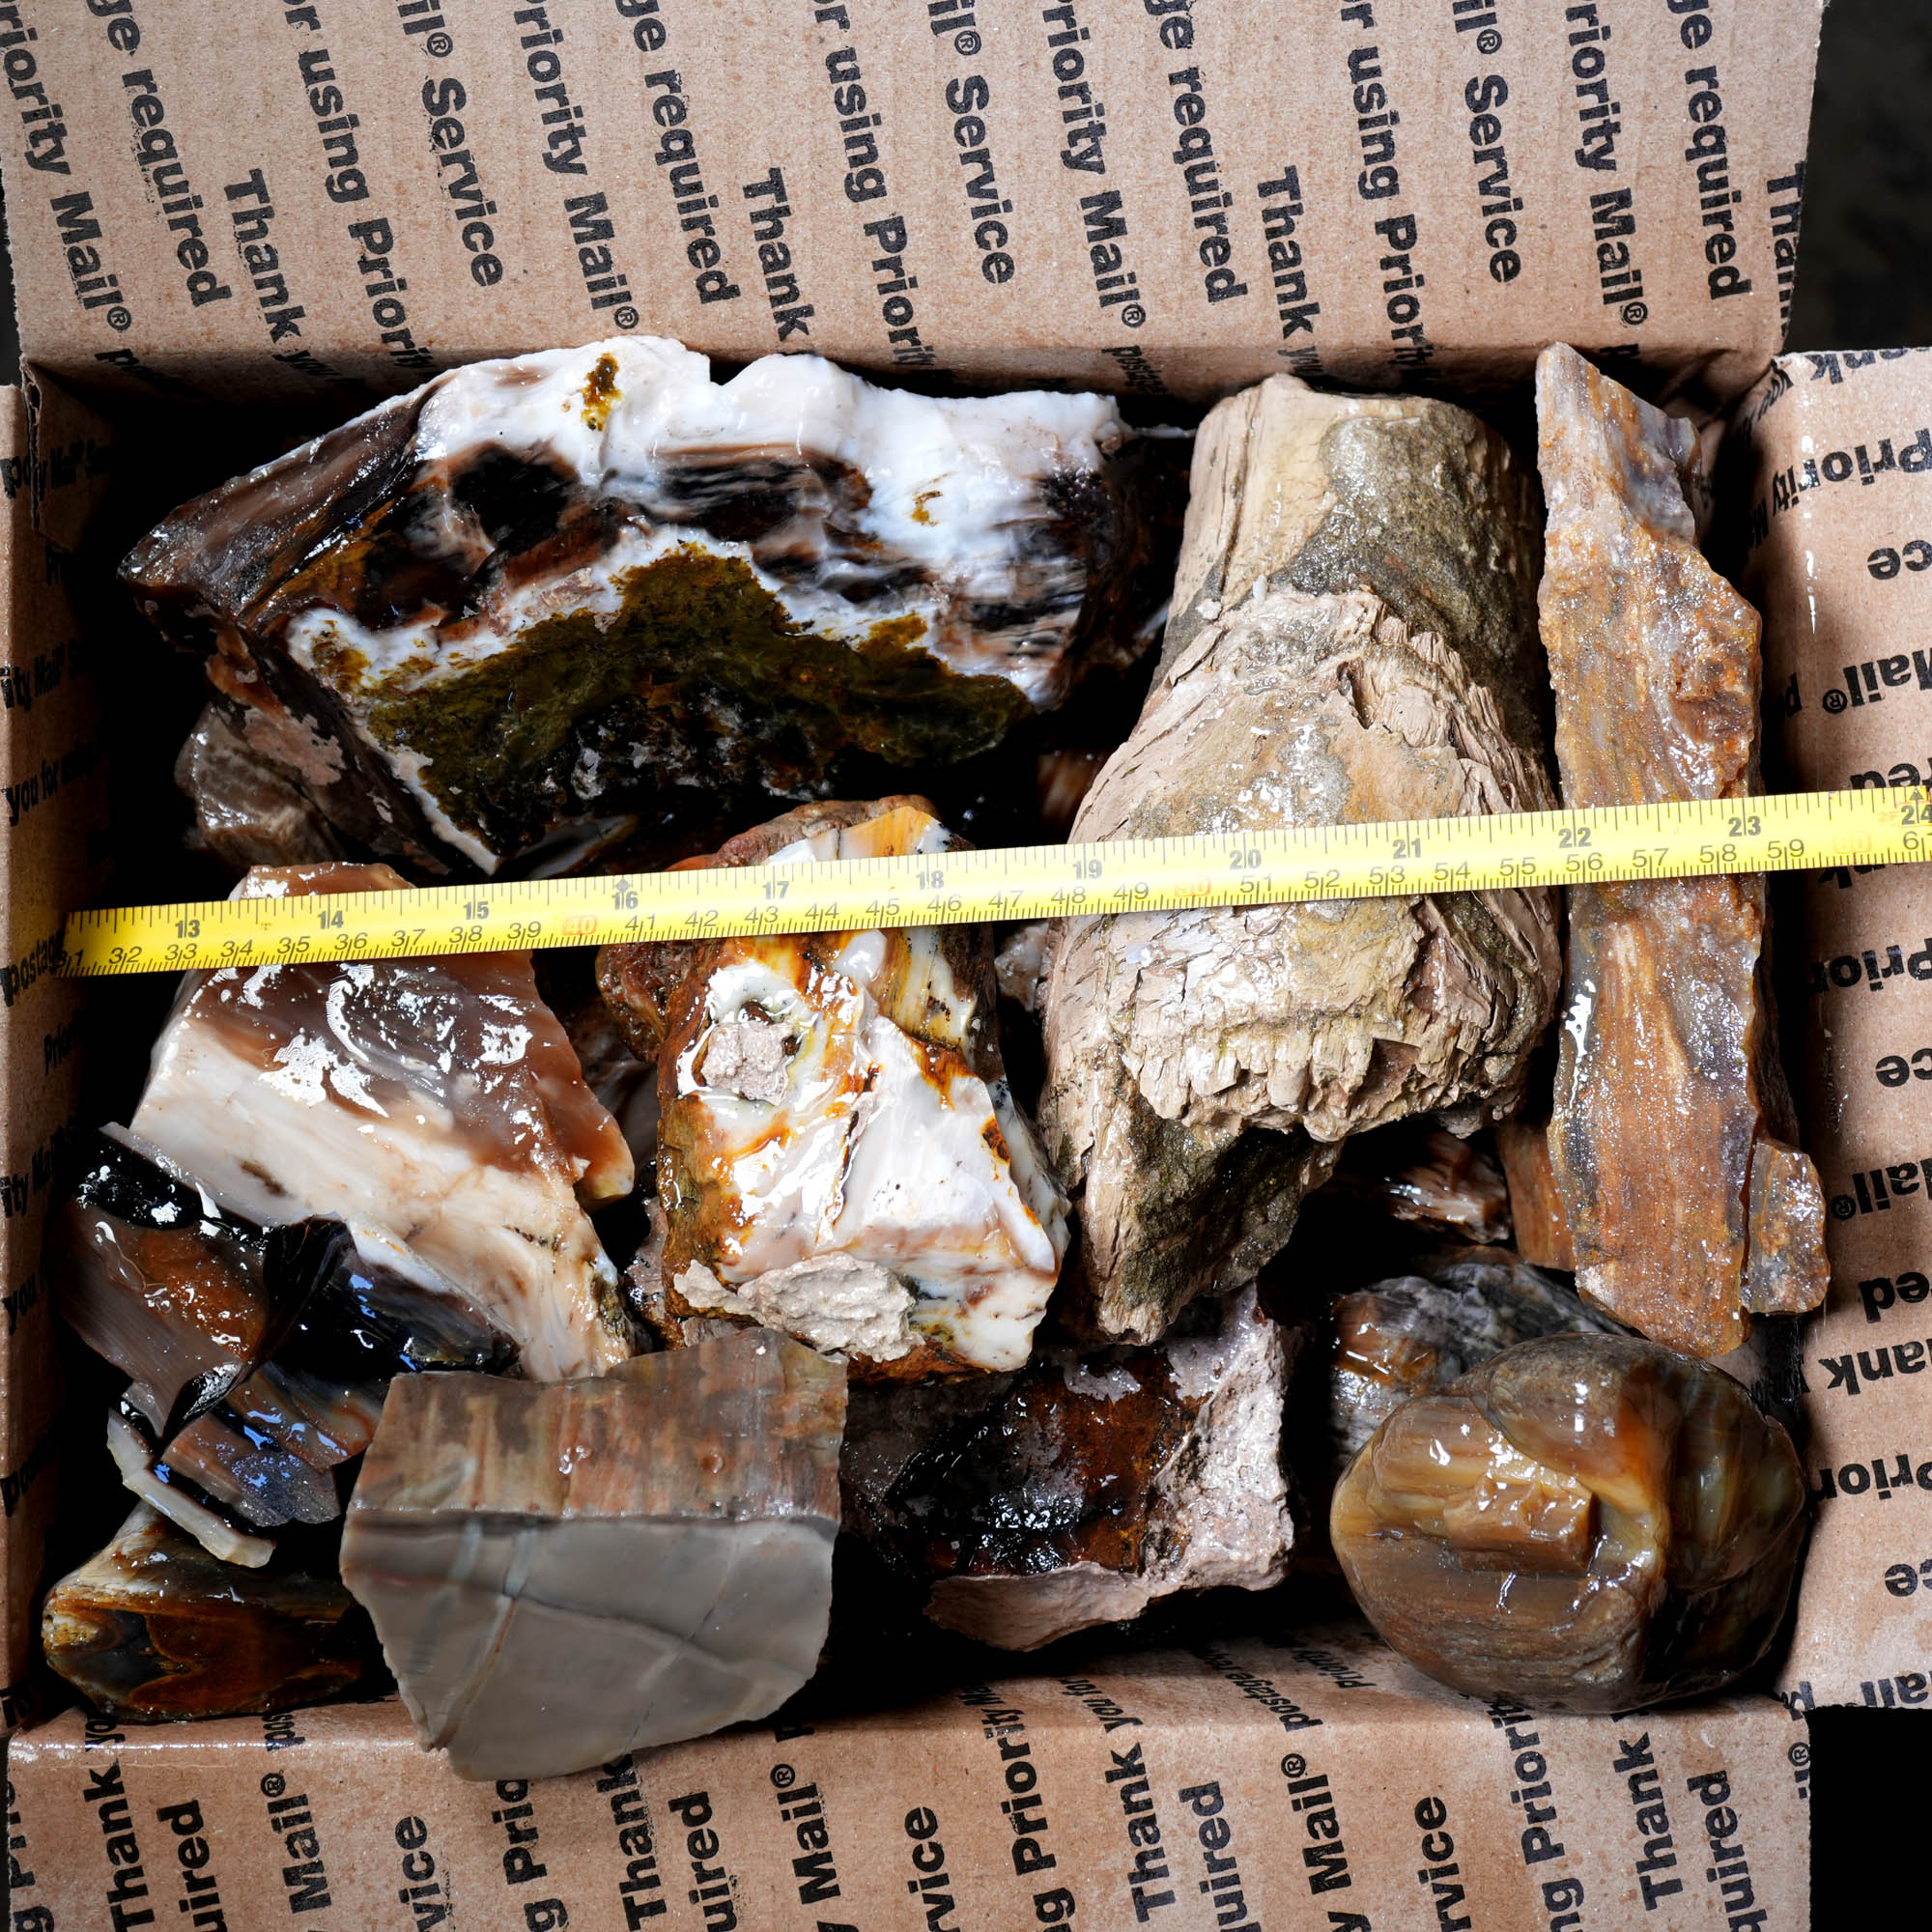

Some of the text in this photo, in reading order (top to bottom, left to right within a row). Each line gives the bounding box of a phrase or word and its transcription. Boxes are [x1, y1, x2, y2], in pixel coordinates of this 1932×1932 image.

[121, 69, 232, 307] required
[298, 48, 370, 203] using
[422, 77, 503, 286] Service
[644, 70, 741, 304] required
[825, 46, 888, 203] using
[946, 75, 1014, 284] Service
[1168, 66, 1248, 302] required
[1348, 45, 1400, 200] using
[1464, 74, 1523, 283] Service
[1685, 65, 1752, 300] required
[223, 167, 306, 344] Thank
[743, 167, 814, 341] Thank
[1258, 164, 1321, 340] Thank
[108, 947, 142, 964] 32
[165, 943, 197, 961] 33
[220, 939, 254, 958] 34
[276, 936, 310, 955] 35
[334, 931, 368, 951] 36
[391, 928, 426, 948] 37
[448, 924, 483, 944] 38
[507, 921, 542, 940] 39
[625, 914, 659, 932] 41
[684, 908, 720, 927] 42
[744, 905, 780, 923] 43
[805, 900, 840, 920] 44
[866, 897, 901, 917] 45
[926, 893, 963, 913] 46
[988, 889, 1024, 909] 47
[1050, 886, 1088, 906] 48
[1113, 881, 1151, 902] 49
[1238, 873, 1274, 894] 51
[1303, 869, 1341, 890] 52
[1368, 865, 1406, 885] 53
[1433, 861, 1470, 881] 54
[1499, 857, 1537, 878] 55
[1568, 853, 1605, 873] 56
[1633, 848, 1669, 869] 57
[1699, 843, 1738, 865] 58
[1767, 838, 1805, 860] 59
[175, 816, 1762, 939] 13 14 15 16 17 18 19 20 21 22 23
[1082, 1698, 1144, 1734] you
[1225, 1672, 1324, 1732] postage
[84, 1758, 155, 1932] Thank
[595, 1753, 668, 1931] Thank
[981, 1708, 1057, 1876] Priority
[1105, 1742, 1177, 1923] Thank
[1612, 1731, 1684, 1912] Thank
